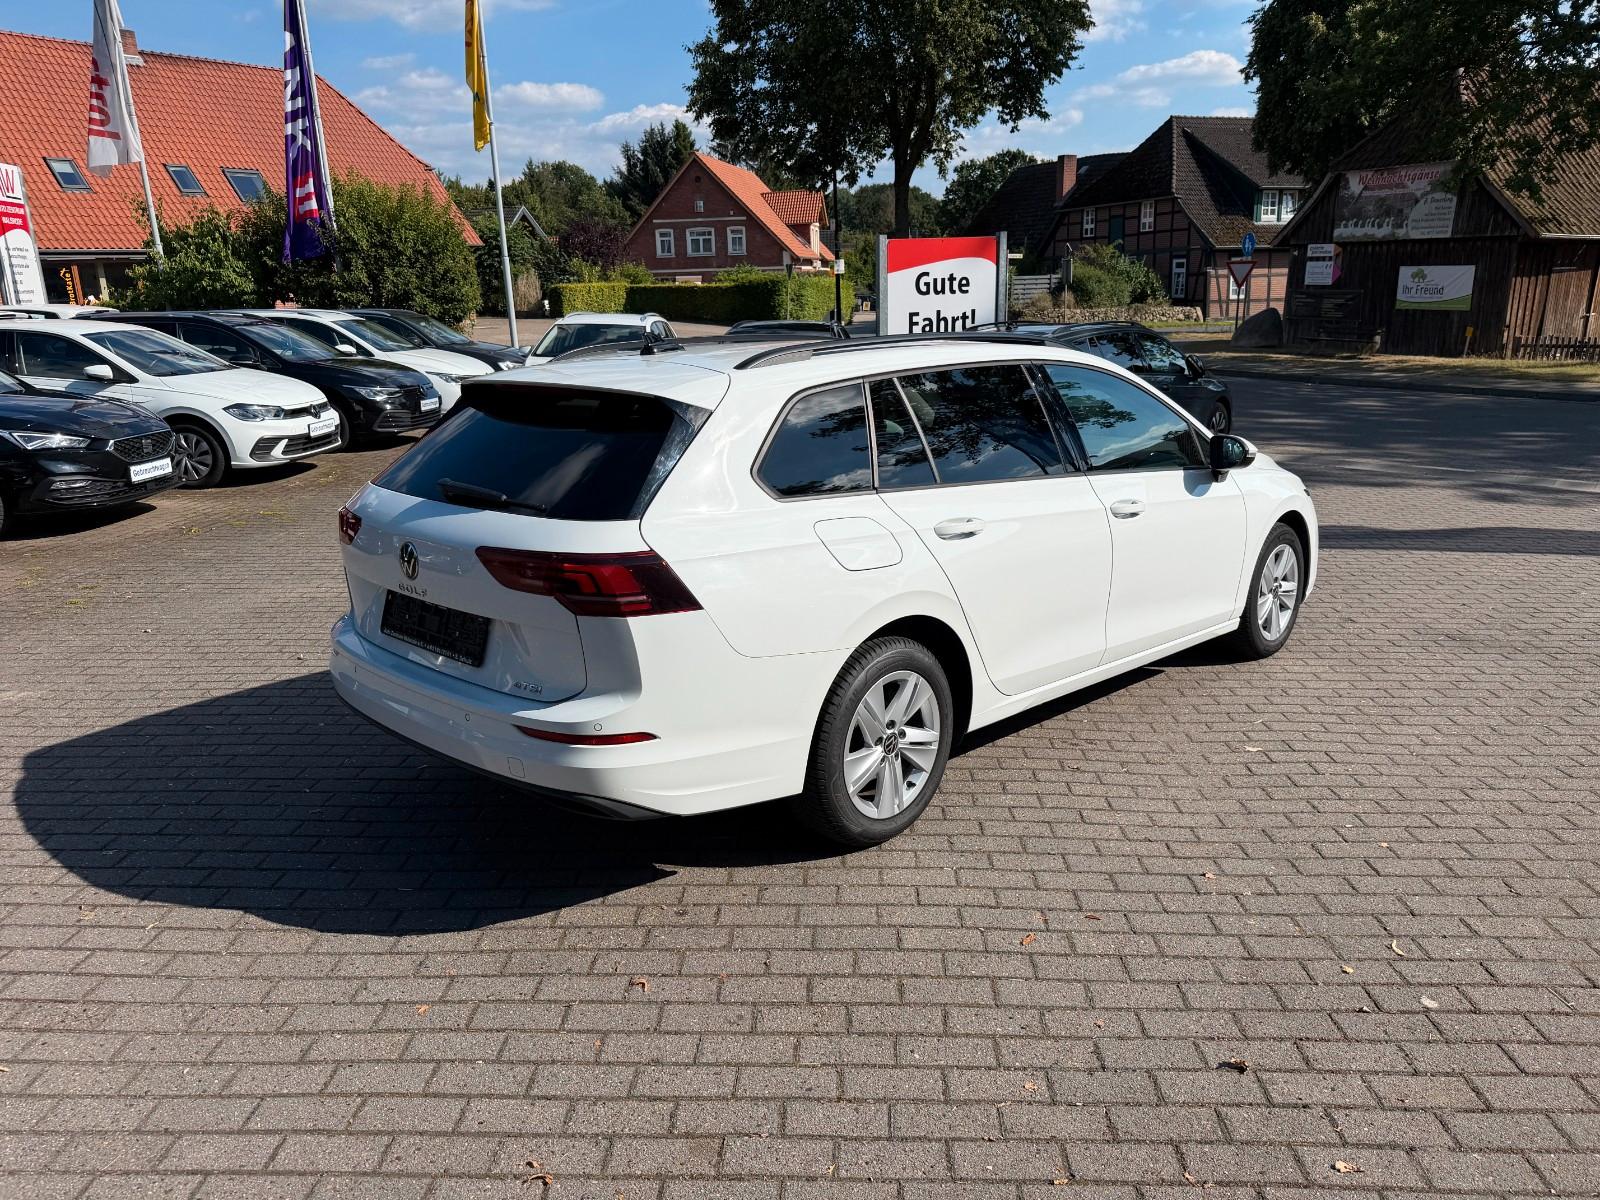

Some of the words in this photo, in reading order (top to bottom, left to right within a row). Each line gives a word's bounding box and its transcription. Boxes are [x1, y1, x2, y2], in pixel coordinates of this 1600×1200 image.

[915, 271, 971, 296] Gute
[1402, 284, 1414, 295] Ihr
[1415, 284, 1444, 296] Freund
[908, 308, 976, 334] Fahrt!
[398, 583, 428, 597] GOLF
